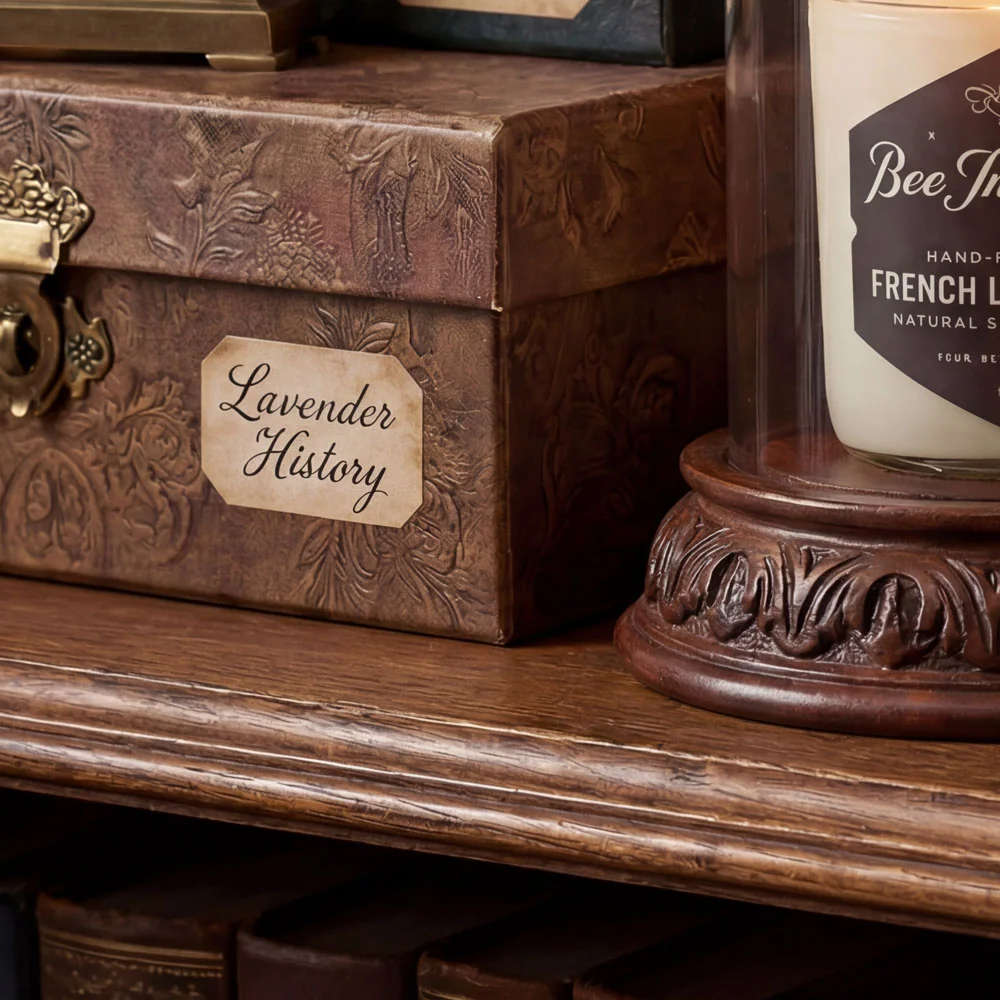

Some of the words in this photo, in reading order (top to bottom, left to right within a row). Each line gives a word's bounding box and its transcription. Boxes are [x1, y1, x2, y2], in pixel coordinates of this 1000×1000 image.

[864, 140, 947, 204] Bee
[871, 268, 977, 305] FRENCH
[893, 312, 978, 329] NATURAL
[219, 362, 396, 430] Lavender
[242, 426, 389, 514] History
